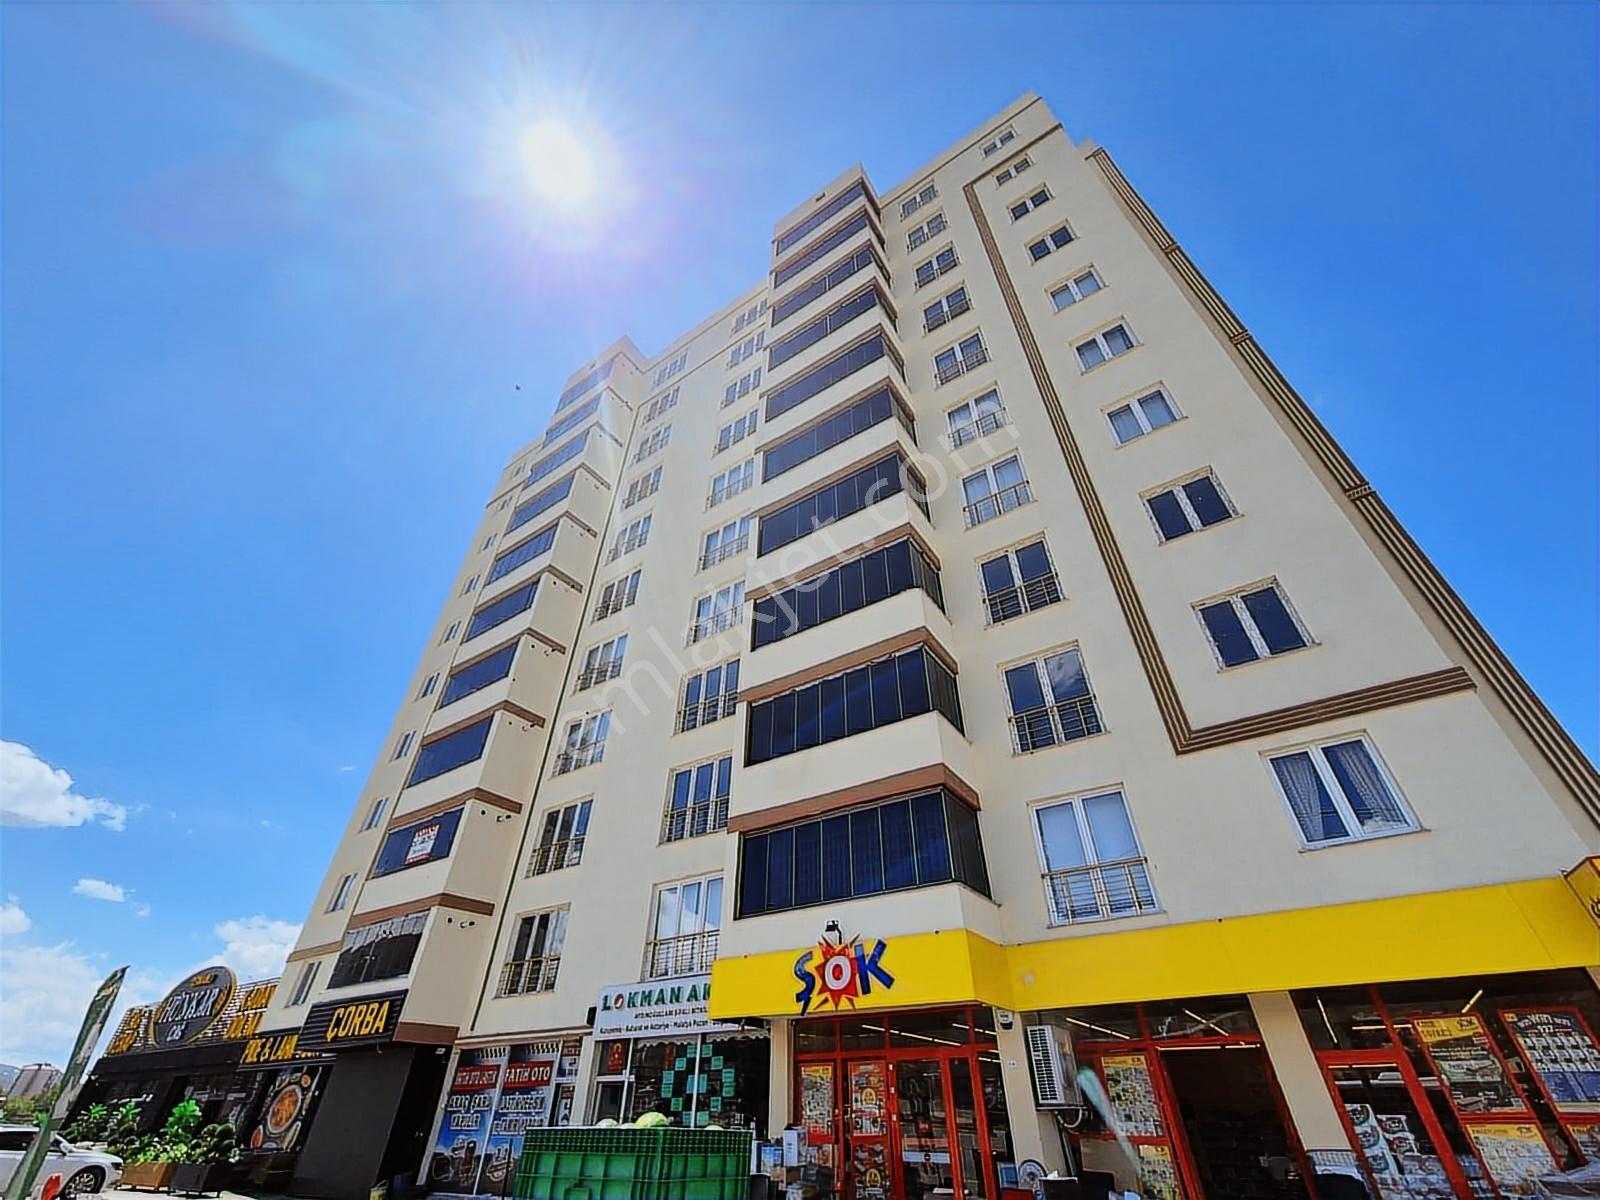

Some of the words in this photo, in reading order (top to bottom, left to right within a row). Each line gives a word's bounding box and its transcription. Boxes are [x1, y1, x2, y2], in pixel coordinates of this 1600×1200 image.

[601, 986, 682, 1012] LOKMAN
[325, 1001, 390, 1042] ÇORBA
[504, 1063, 530, 1083] FATİH
[531, 1066, 551, 1081] OTO
